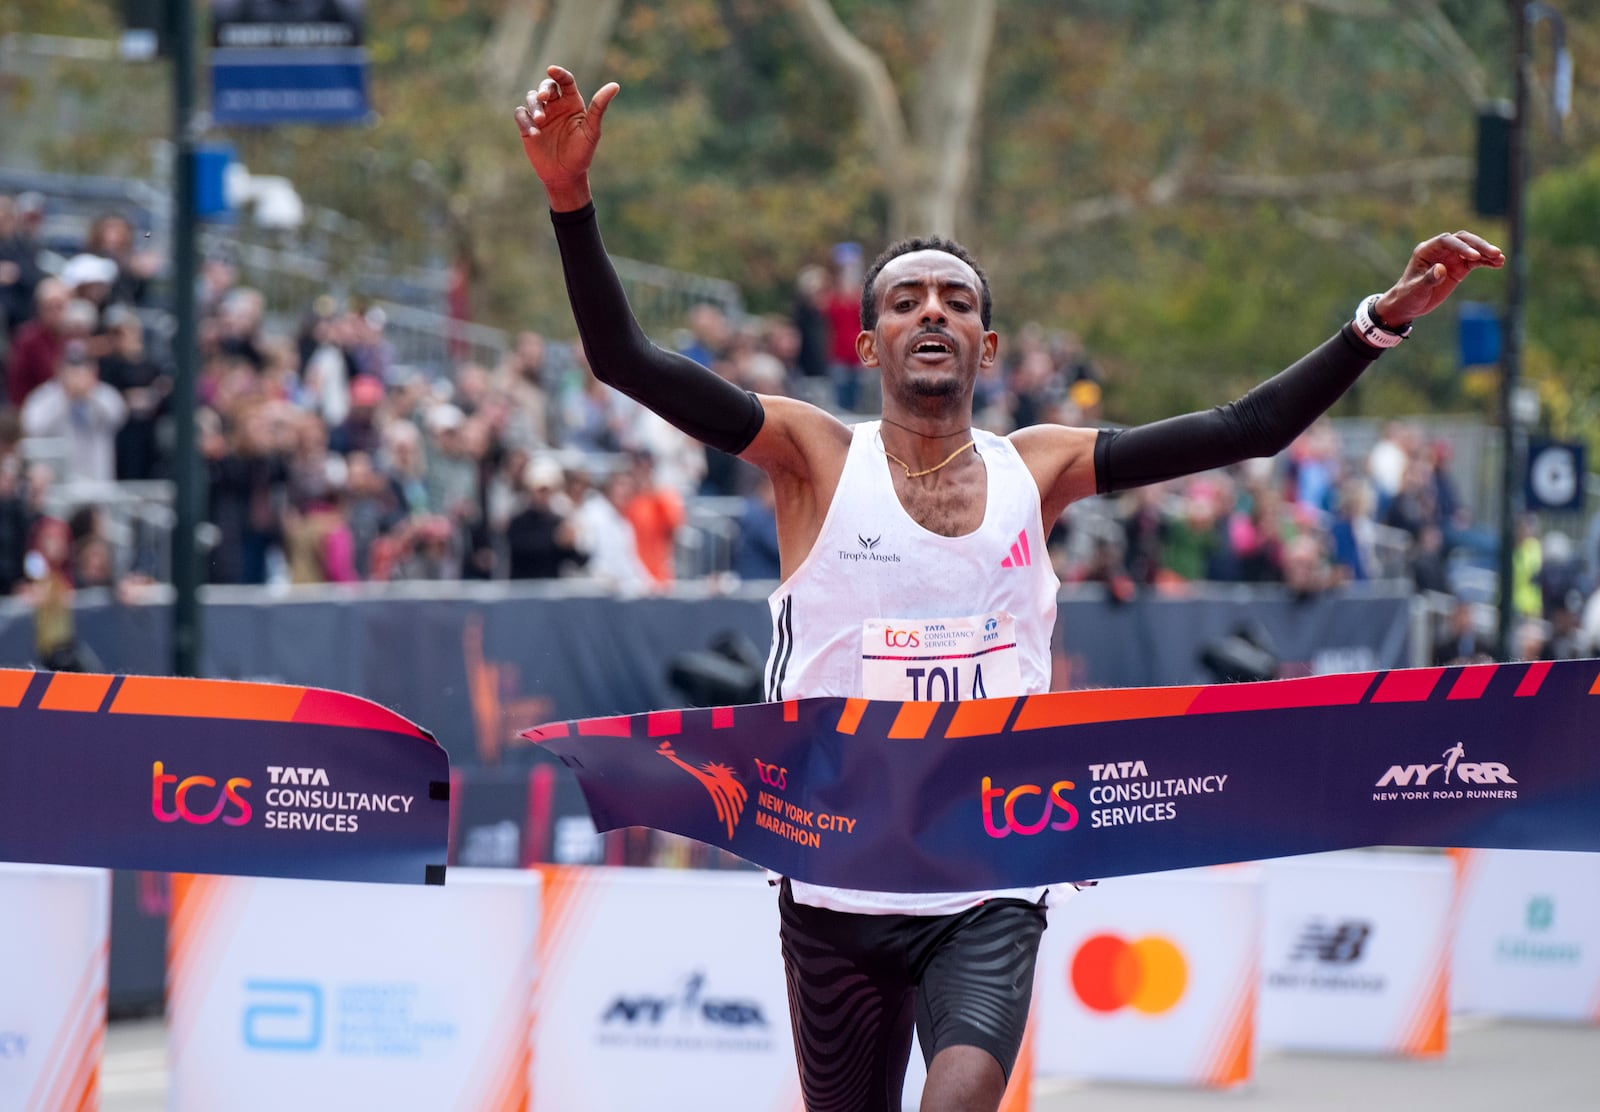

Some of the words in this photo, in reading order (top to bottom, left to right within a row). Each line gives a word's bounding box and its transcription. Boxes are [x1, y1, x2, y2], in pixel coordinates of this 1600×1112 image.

[1532, 447, 1575, 505] 6
[838, 551, 868, 562] Tirop's
[869, 552, 901, 563] Angels
[885, 625, 920, 648] tcs
[924, 624, 946, 632] TATA
[924, 631, 975, 640] CONSULTANCY
[983, 632, 999, 642] TATA
[924, 641, 957, 649] SERVICES
[267, 766, 330, 787] TATA
[754, 758, 788, 790] tcs
[1089, 760, 1149, 782] TATA
[152, 760, 253, 827] tcs
[265, 789, 415, 813] CONSULTANCY
[1089, 775, 1228, 805] CONSULTANCY
[1372, 792, 1399, 801] NEW
[1400, 791, 1430, 800] YORK
[1432, 790, 1464, 800] ROAD
[1466, 789, 1519, 799] RUNNERS
[758, 791, 784, 814] NEW
[784, 801, 814, 828] YORK
[817, 813, 857, 834] CITY
[981, 776, 1080, 839] tcs
[1091, 802, 1177, 829] SERVICES
[265, 811, 359, 832] SERVICES
[756, 810, 821, 849] MARATHON
